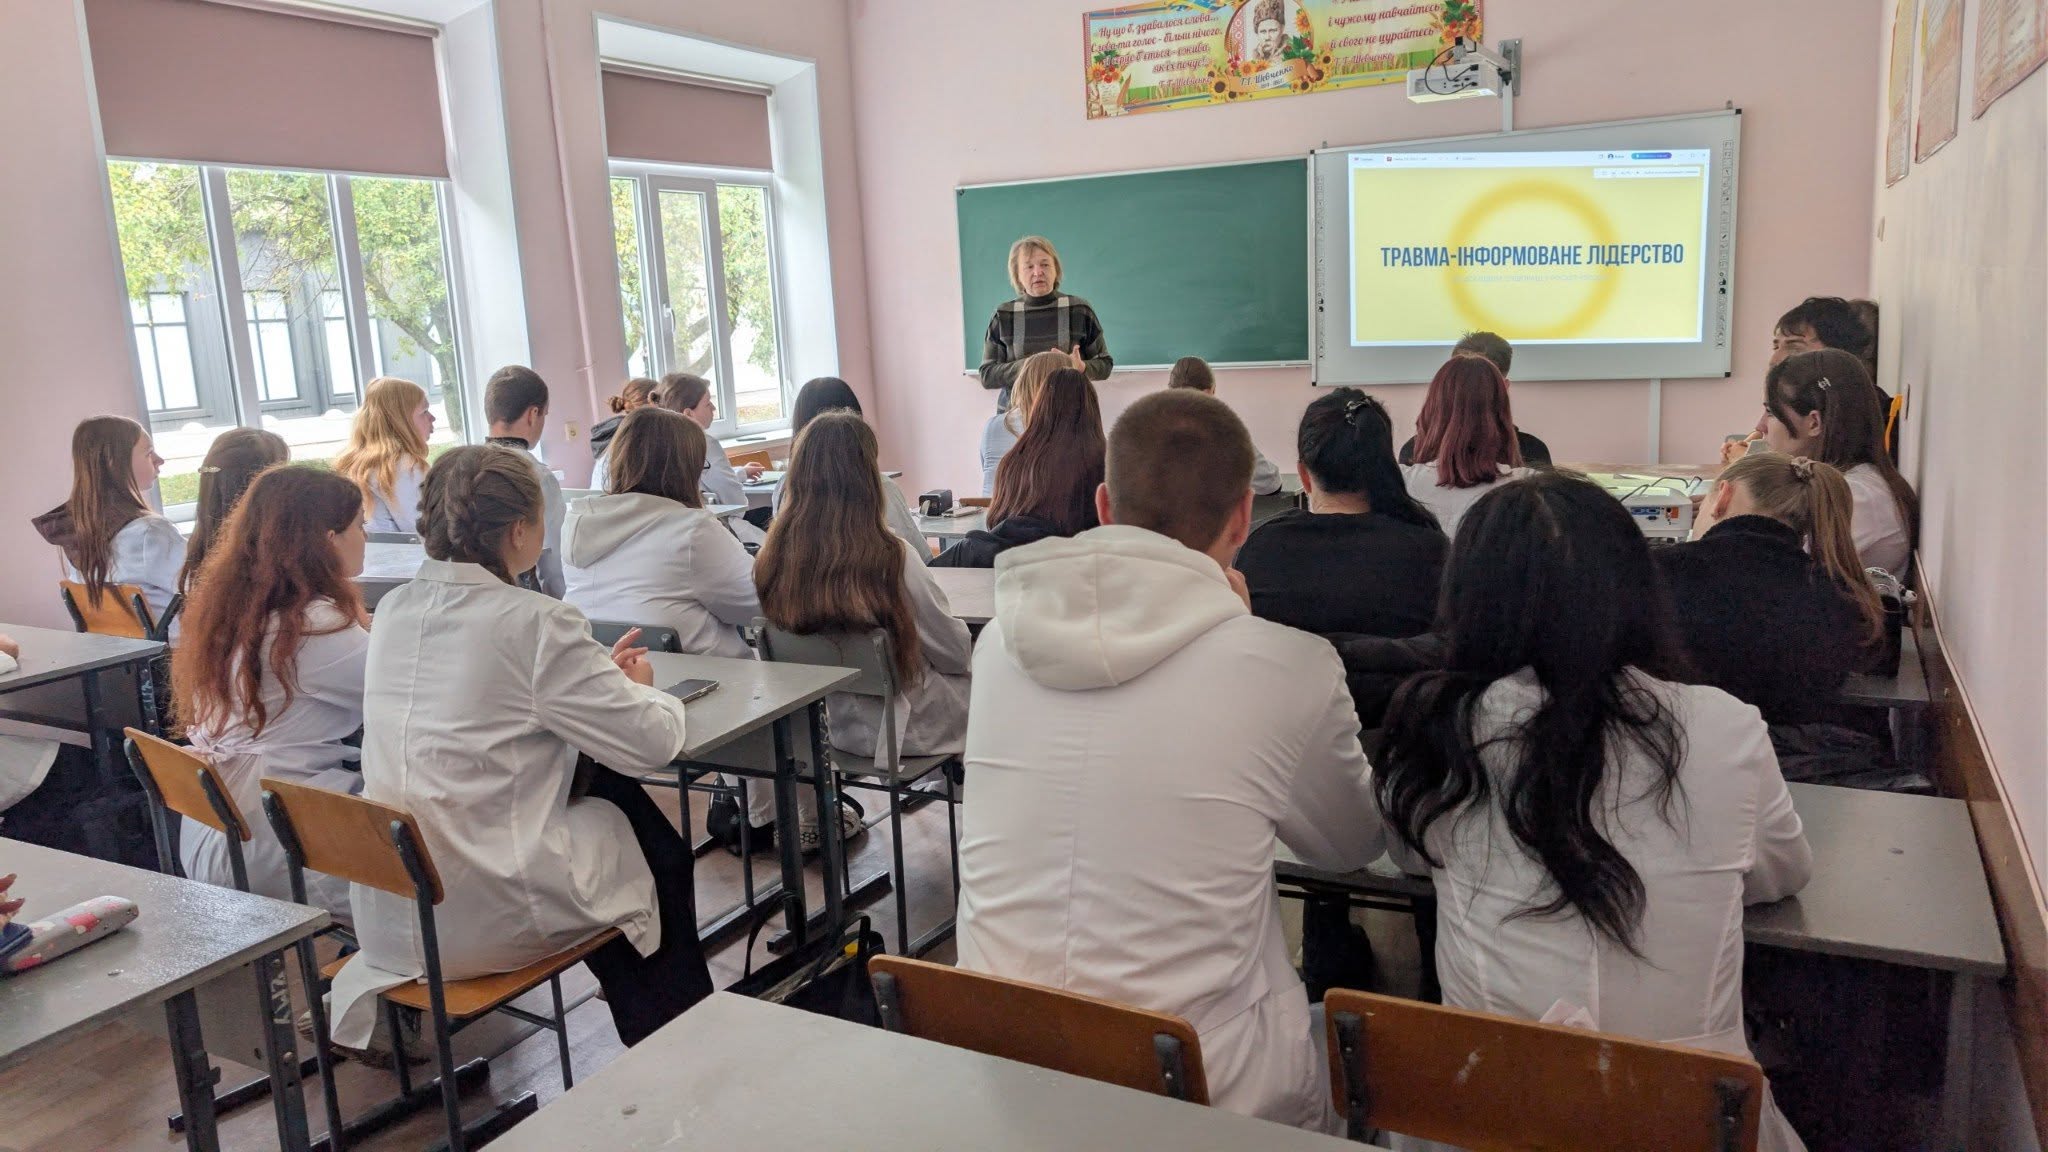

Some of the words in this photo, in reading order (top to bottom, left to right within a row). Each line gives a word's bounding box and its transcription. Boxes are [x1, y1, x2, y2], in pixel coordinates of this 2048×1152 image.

[1334, 13, 1376, 28] чужому
[1099, 27, 1111, 39] Ну
[1113, 27, 1126, 38] що
[1338, 36, 1364, 48] свого
[1365, 35, 1377, 44] не
[1254, 66, 1294, 83] Шевченко
[1380, 246, 1582, 267] ТРАВМА-ІНФОРМОВАНЕ
[1586, 244, 1684, 267] ЛІДЕРСТВО
